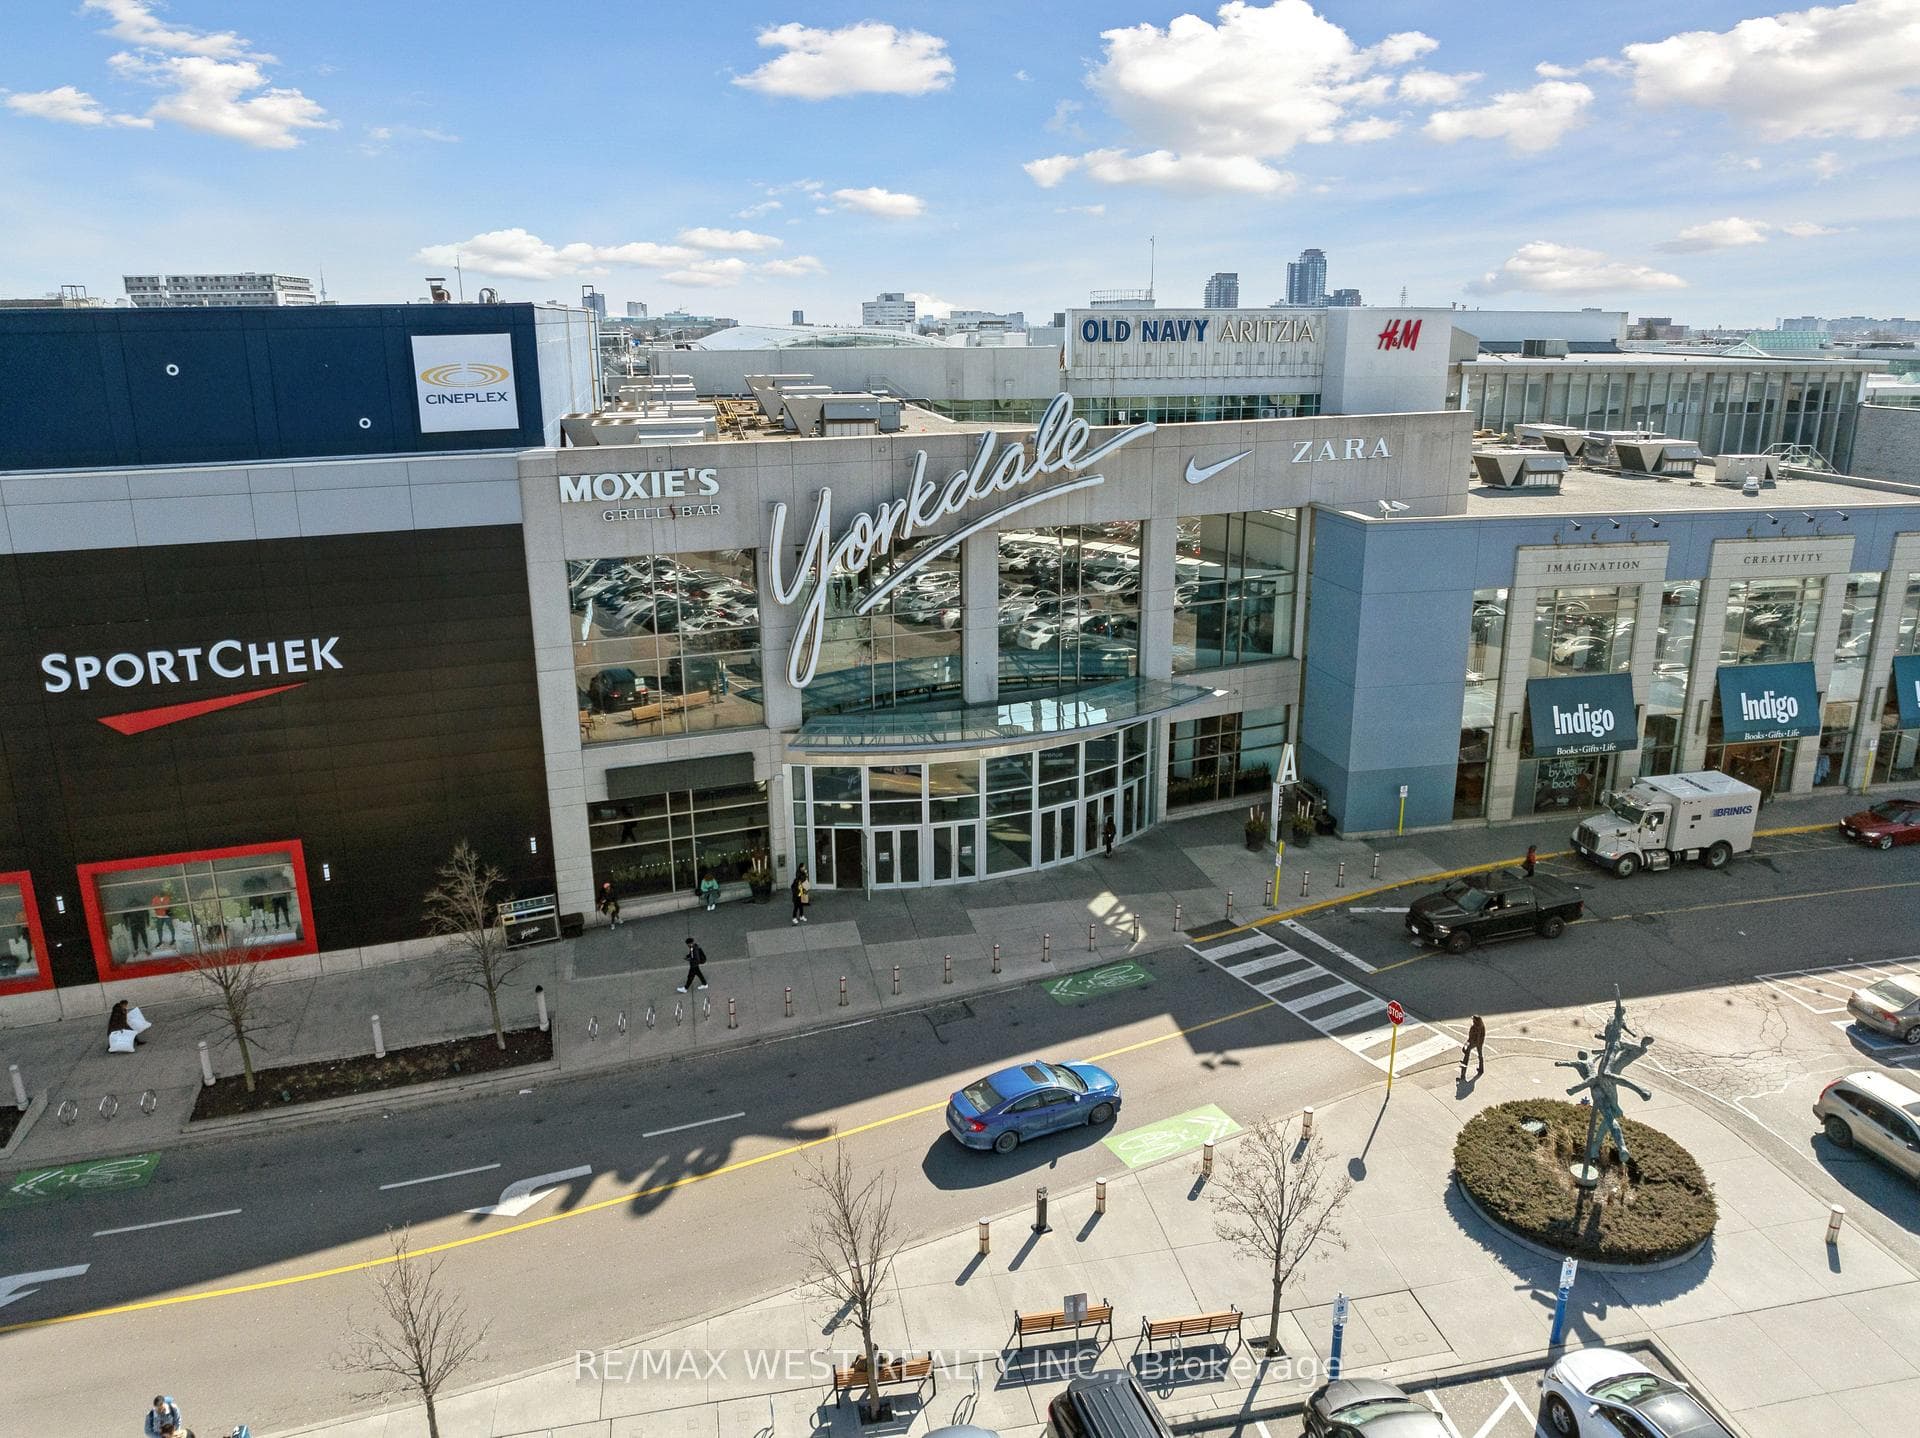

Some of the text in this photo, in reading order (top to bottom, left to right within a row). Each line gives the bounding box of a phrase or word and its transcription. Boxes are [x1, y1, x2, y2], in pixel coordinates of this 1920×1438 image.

[1081, 318, 1209, 343] OLD NAVY
[1219, 319, 1314, 344] ARITZIA
[1377, 318, 1423, 352] H&M
[425, 391, 509, 406] CINEPLEX
[1291, 437, 1392, 464] ZARA
[559, 467, 720, 504] MOXIE'S
[602, 503, 721, 523] GRILL BAR
[767, 391, 1157, 689] Yorkdale
[1546, 560, 1641, 573] IMAGINATION
[1743, 552, 1823, 565] CREATIVITY
[1277, 743, 1298, 783] A
[1548, 765, 1561, 779] by
[1551, 776, 1576, 789] book
[1388, 1006, 1403, 1020] STOP
